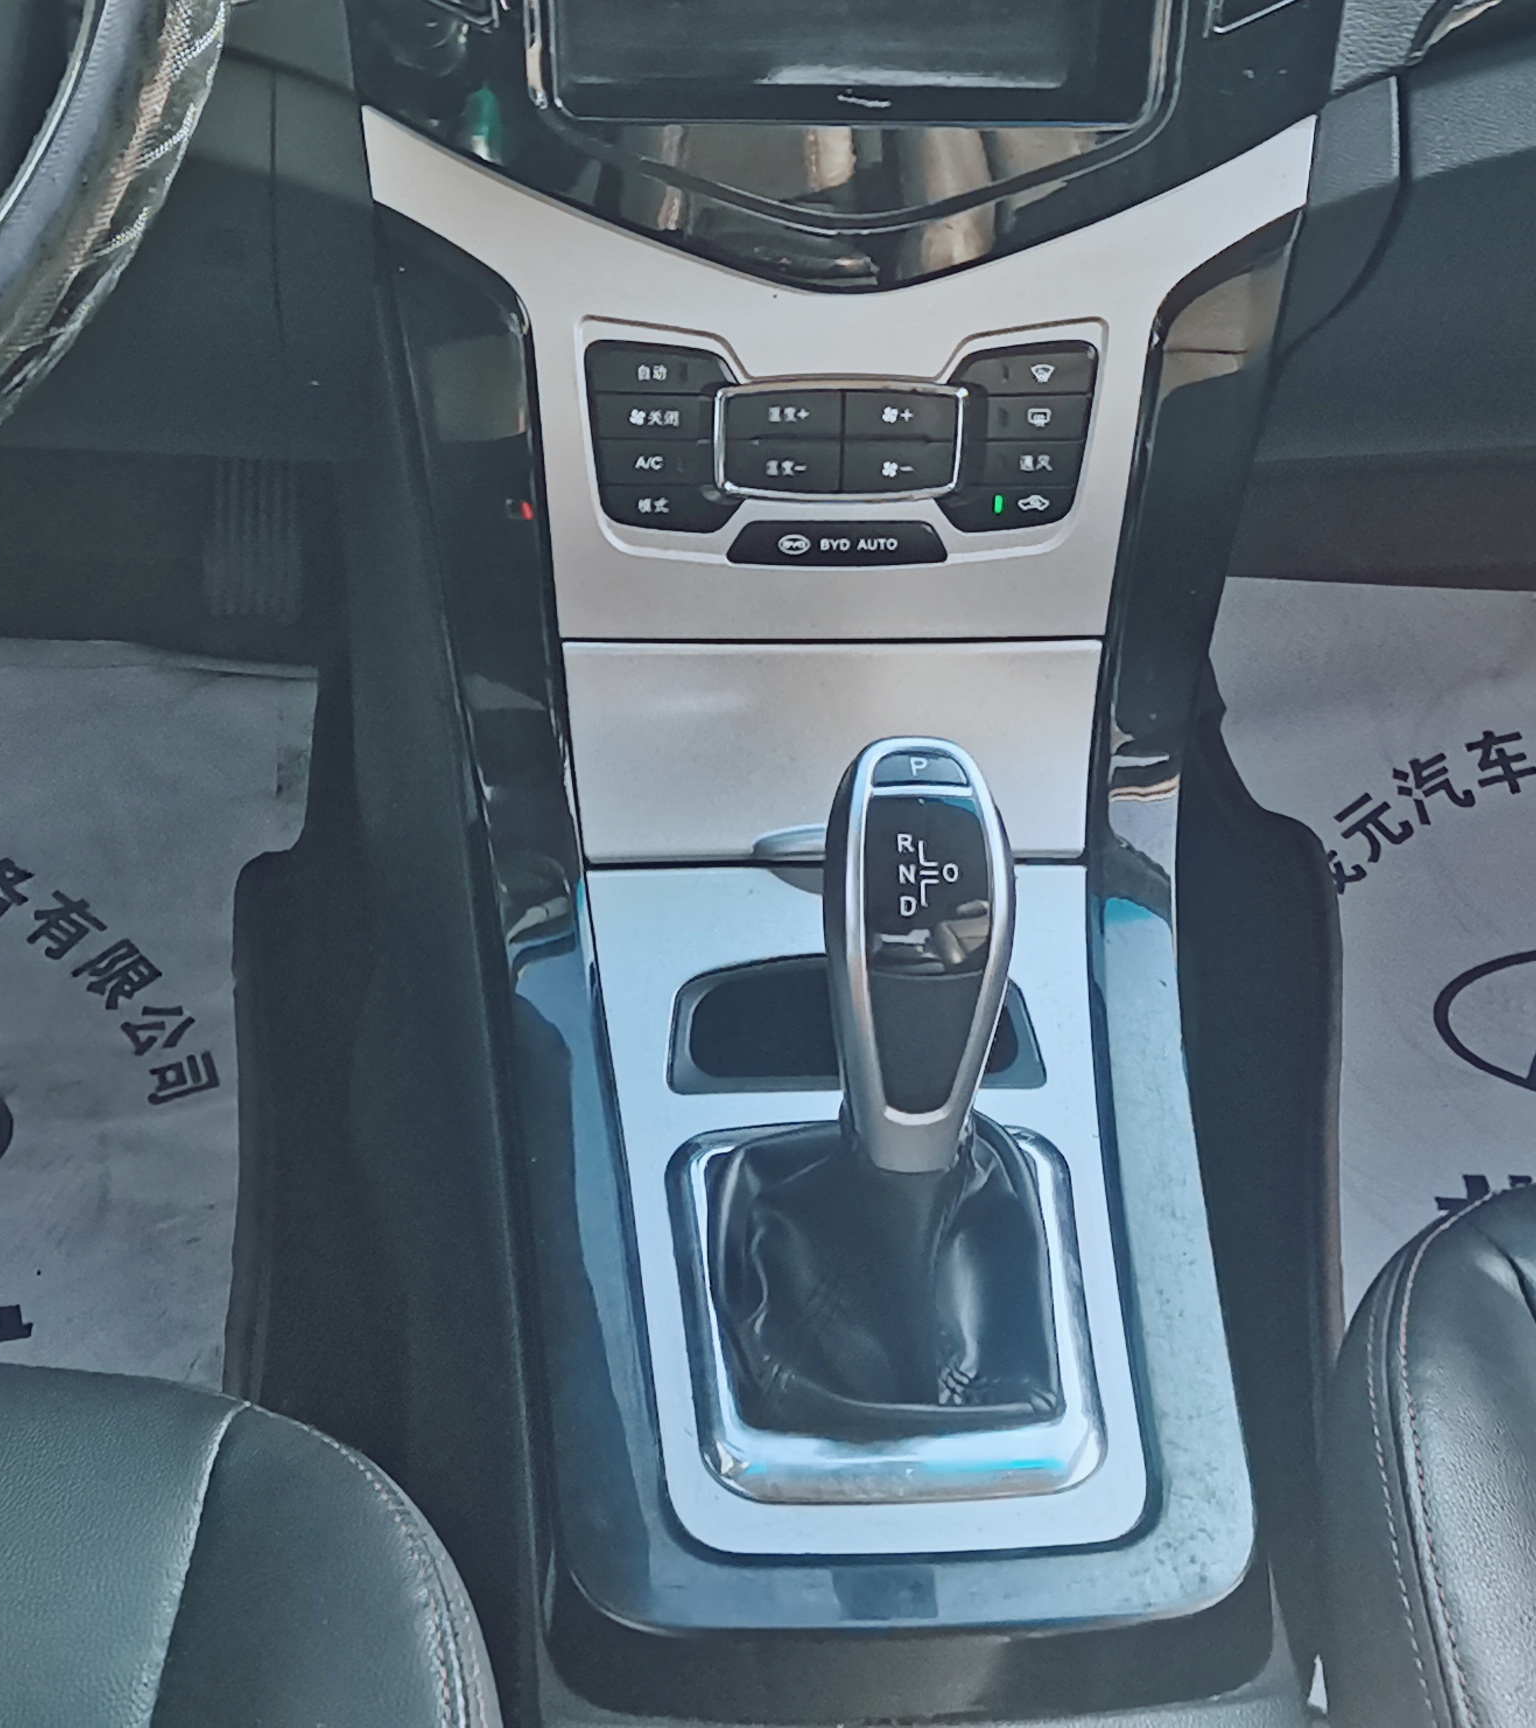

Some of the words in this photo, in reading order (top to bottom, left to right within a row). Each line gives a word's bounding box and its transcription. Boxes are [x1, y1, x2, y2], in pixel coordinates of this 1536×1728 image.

[634, 455, 664, 470] A/C
[820, 537, 851, 551] BYD
[857, 537, 899, 551] AUTO
[910, 756, 929, 776] P
[897, 833, 915, 853] R
[898, 863, 917, 884] N
[900, 895, 917, 916] D
